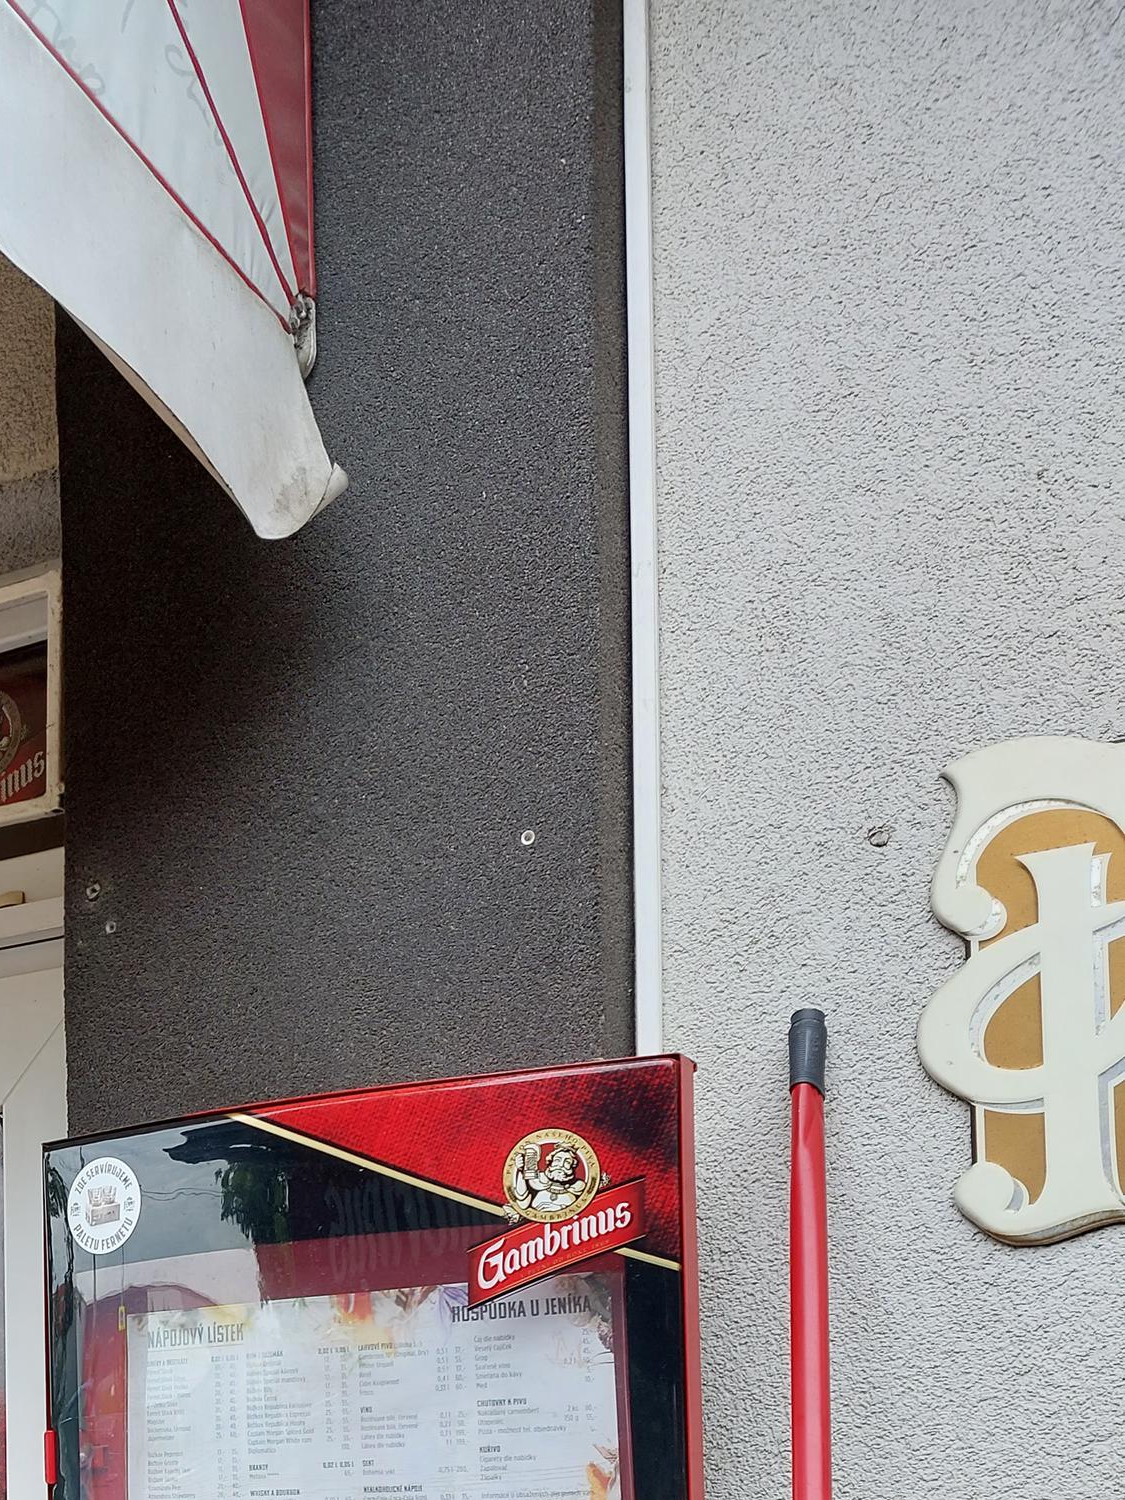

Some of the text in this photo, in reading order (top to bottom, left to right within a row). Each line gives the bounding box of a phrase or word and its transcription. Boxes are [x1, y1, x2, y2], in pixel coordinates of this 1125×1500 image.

[75, 1178, 87, 1194] ZDE
[73, 1224, 100, 1250] PALETU
[477, 1203, 631, 1290] Gambrinus
[531, 1300, 539, 1317] U
[544, 1294, 592, 1316] JENÍKA
[147, 1321, 244, 1349] NÁPOJOVÝ LÍSTEK
